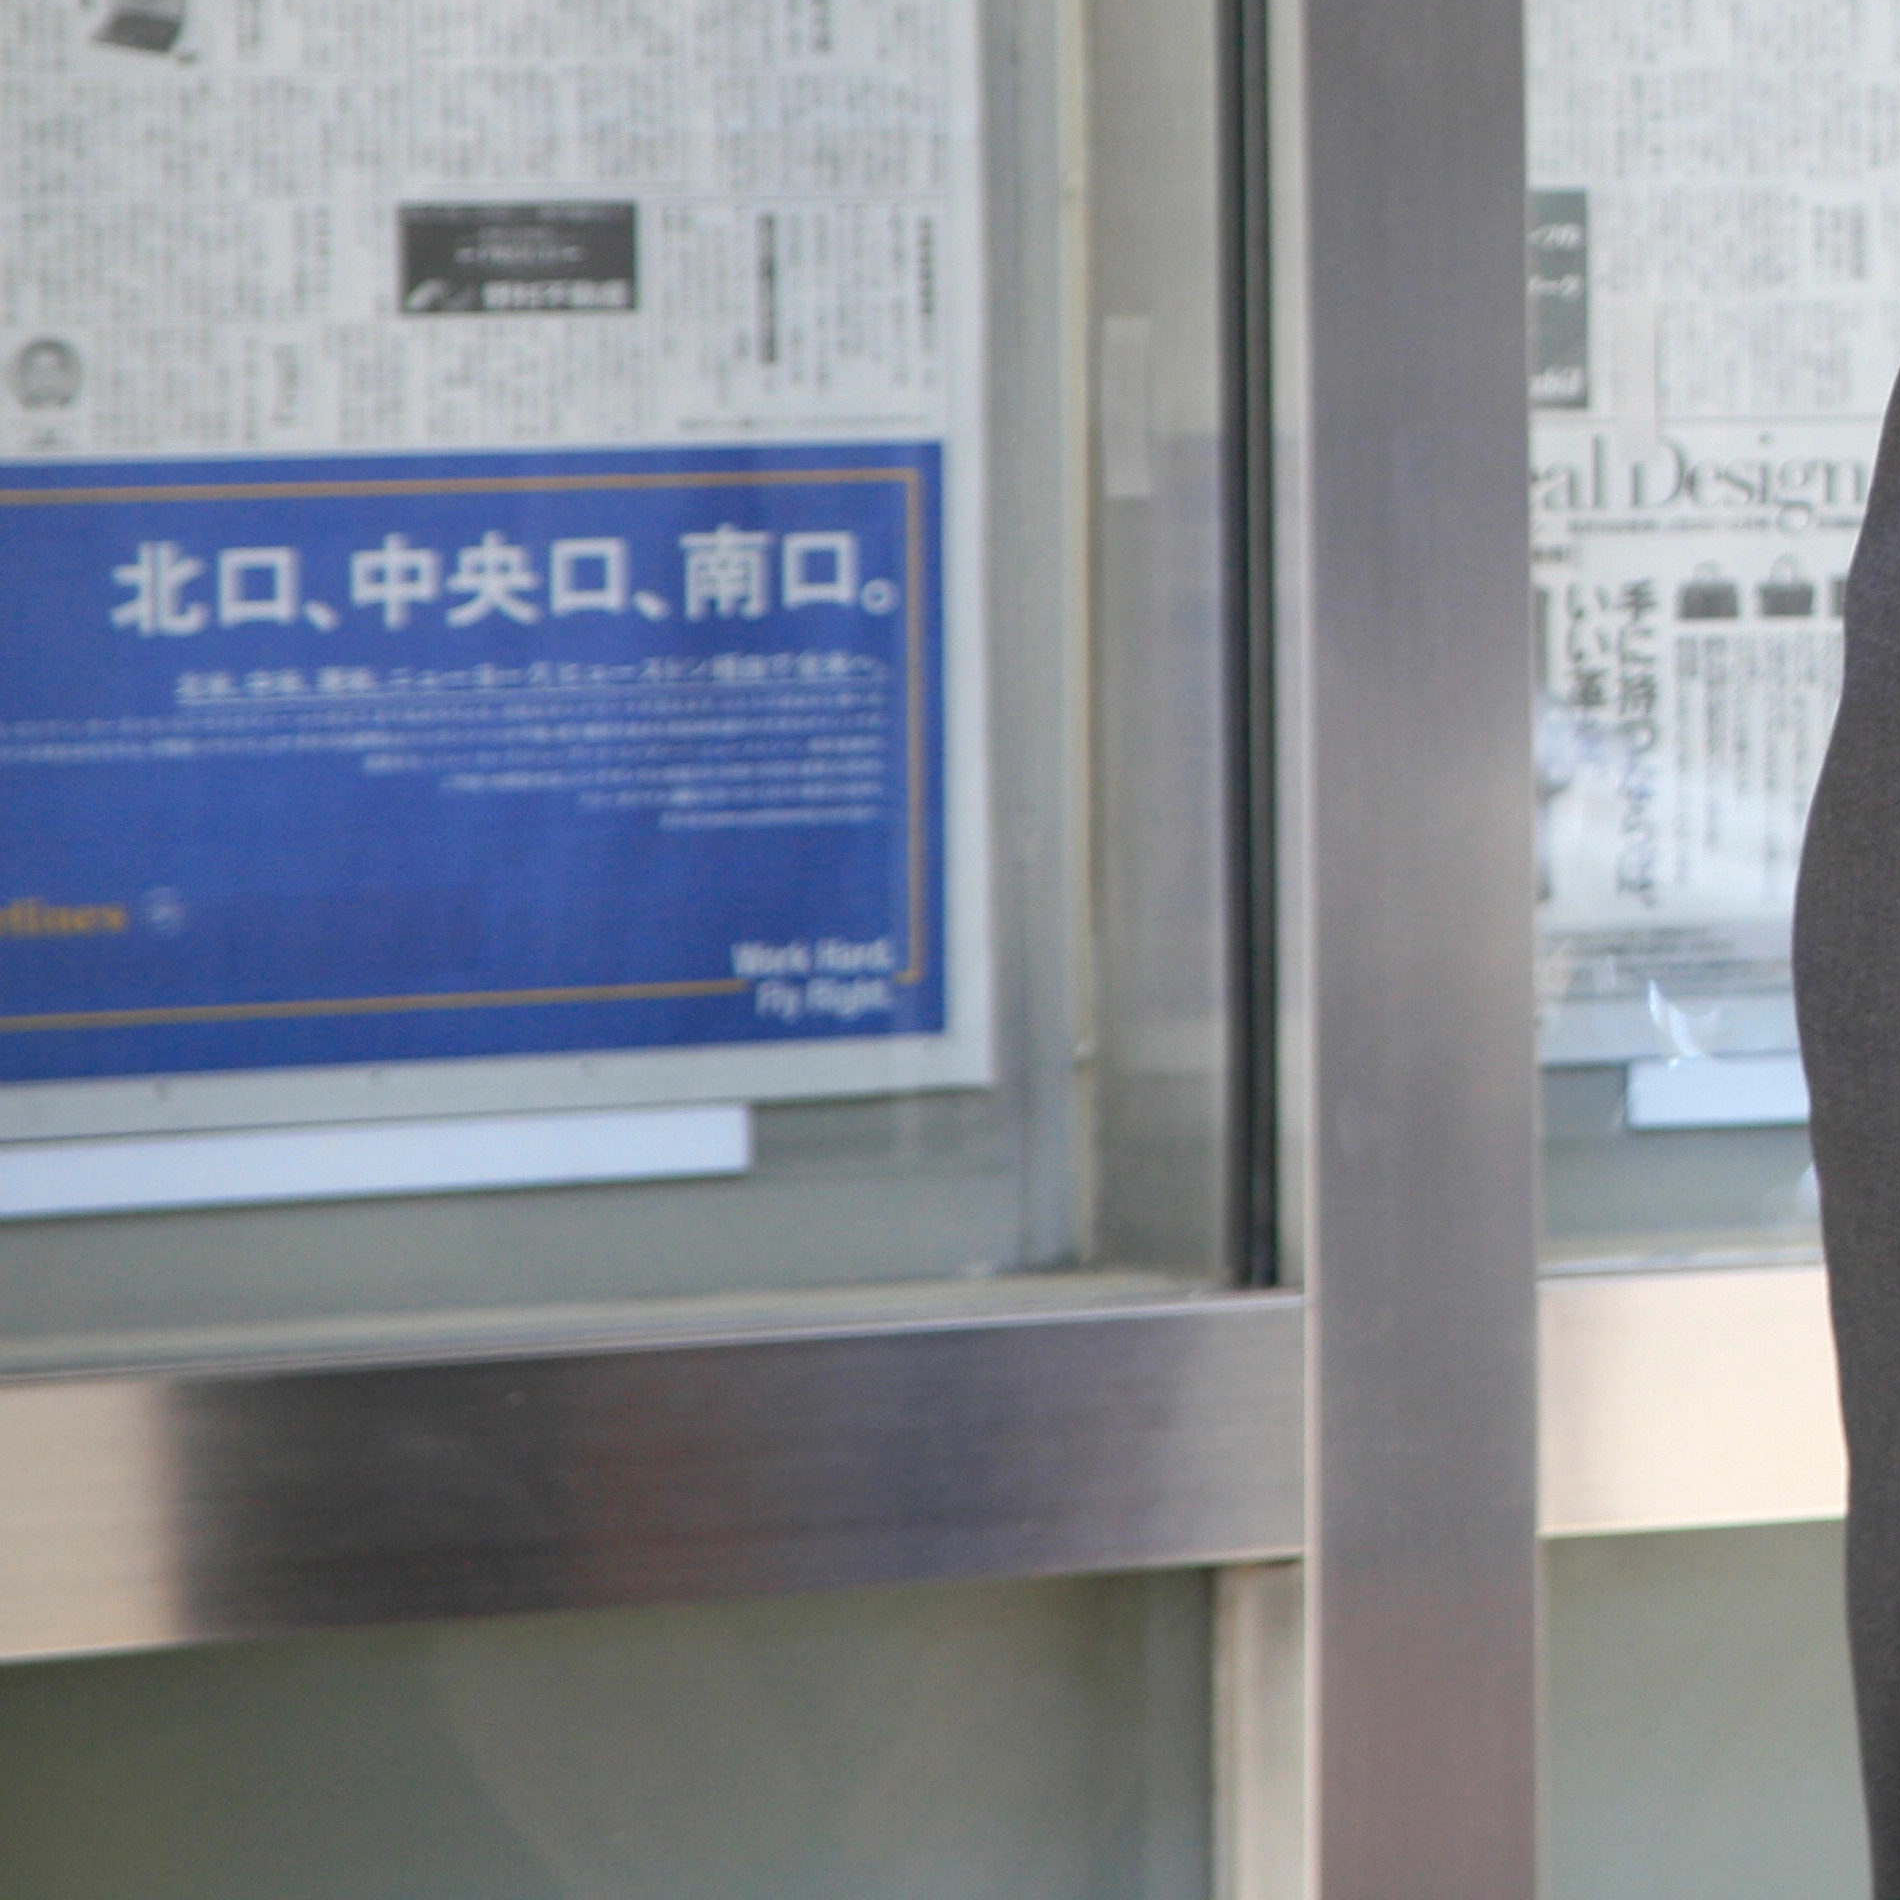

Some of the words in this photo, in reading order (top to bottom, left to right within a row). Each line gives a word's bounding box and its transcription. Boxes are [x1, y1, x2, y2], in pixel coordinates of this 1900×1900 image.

[109, 524, 900, 639] 北口、中央口、南口。
